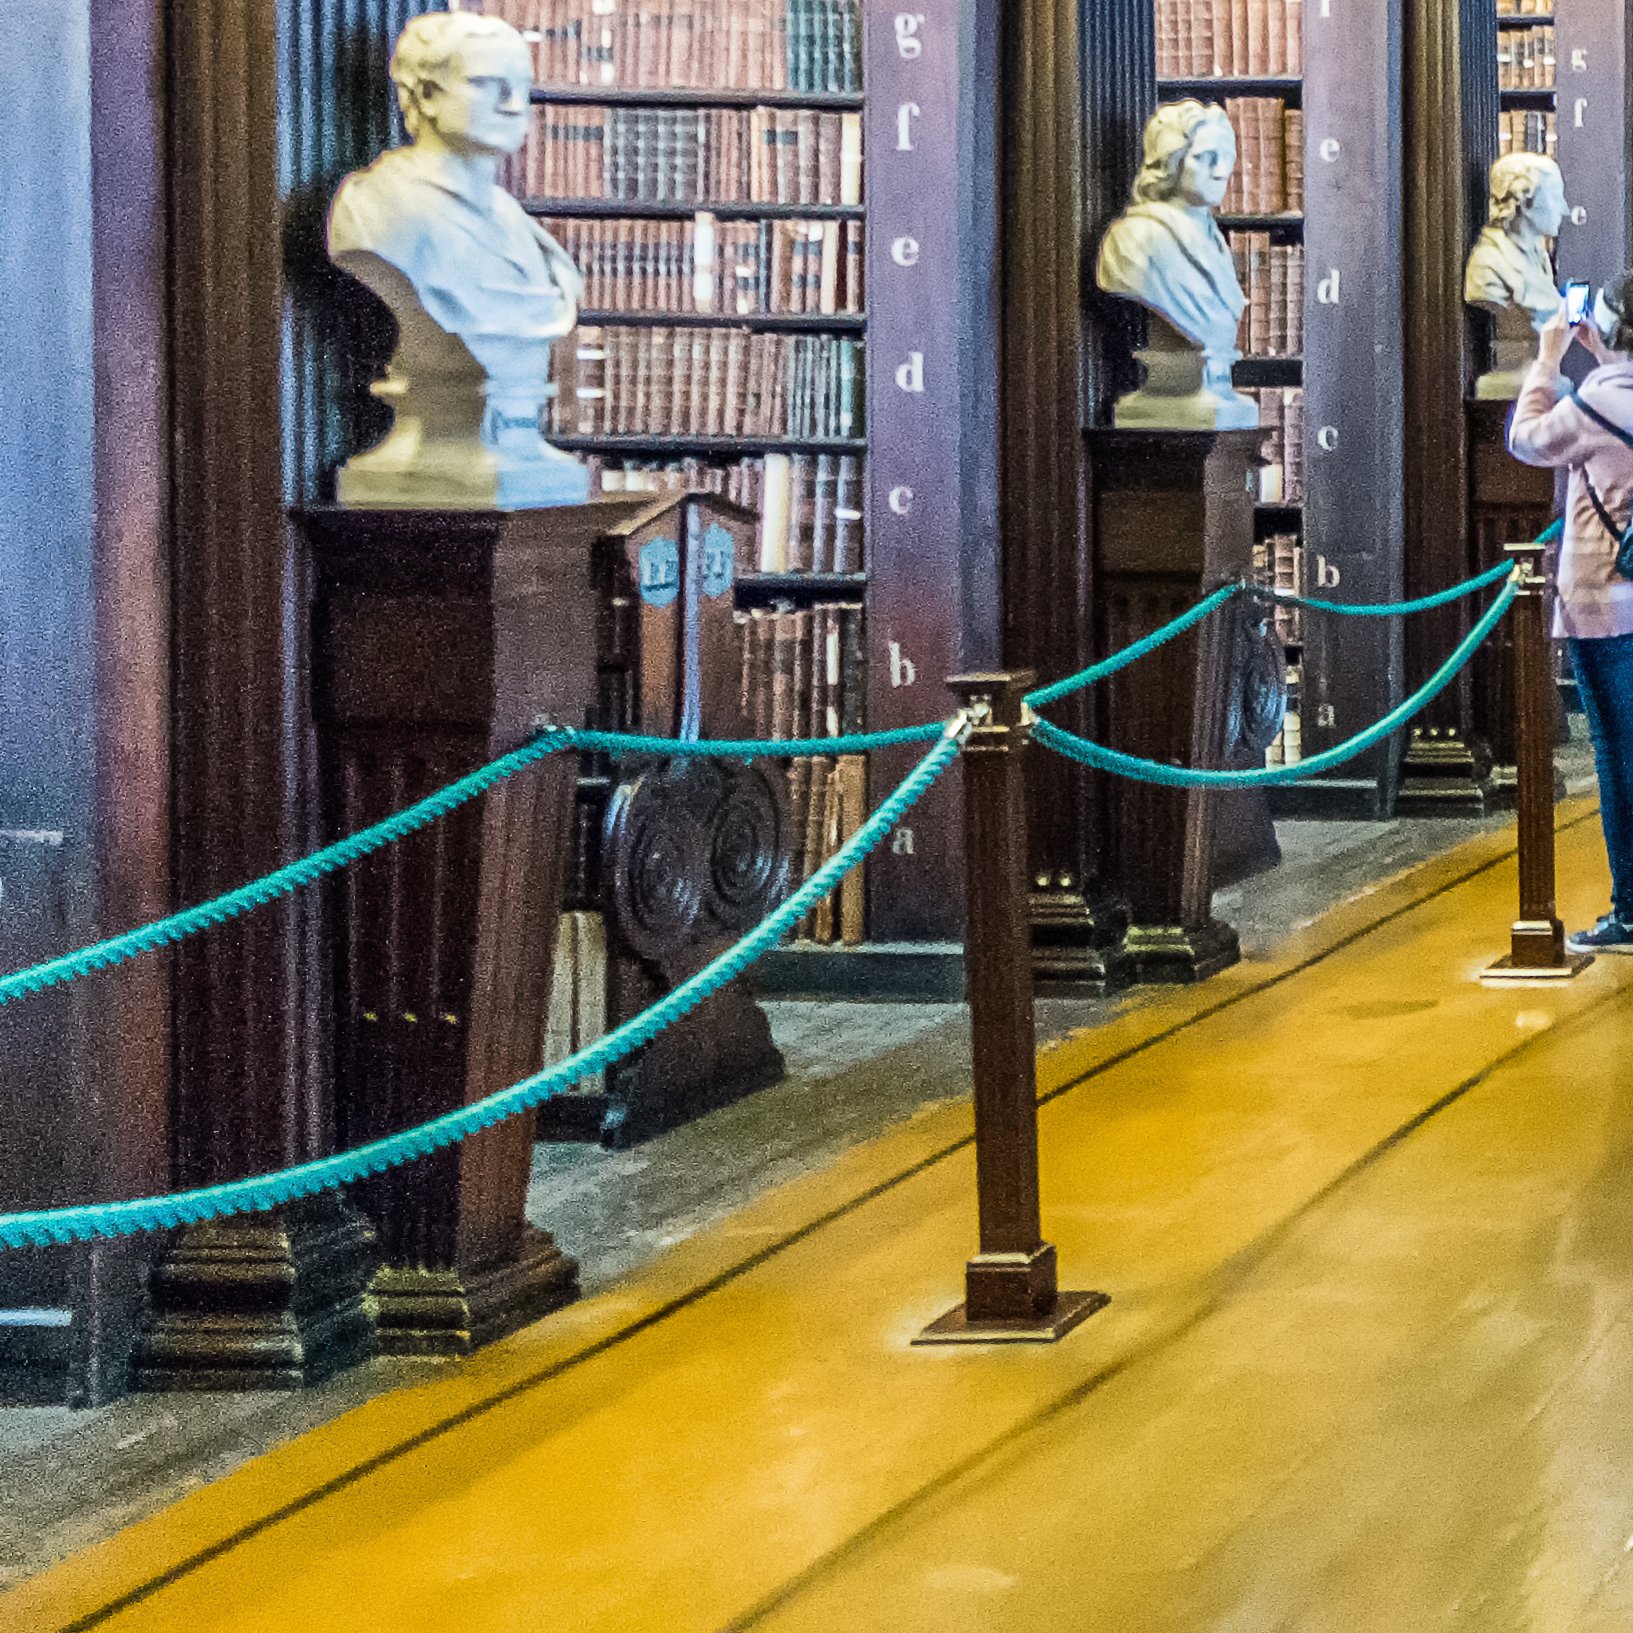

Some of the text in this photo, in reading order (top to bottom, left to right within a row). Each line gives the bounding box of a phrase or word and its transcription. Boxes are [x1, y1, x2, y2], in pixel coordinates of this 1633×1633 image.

[894, 14, 925, 59] g
[896, 102, 920, 151] f
[1319, 138, 1340, 162] e
[891, 237, 919, 266] e
[1317, 268, 1340, 304] d
[895, 351, 924, 392] d
[1317, 426, 1338, 450] c
[888, 486, 913, 514] c
[1316, 555, 1340, 587] b
[887, 640, 916, 688] b
